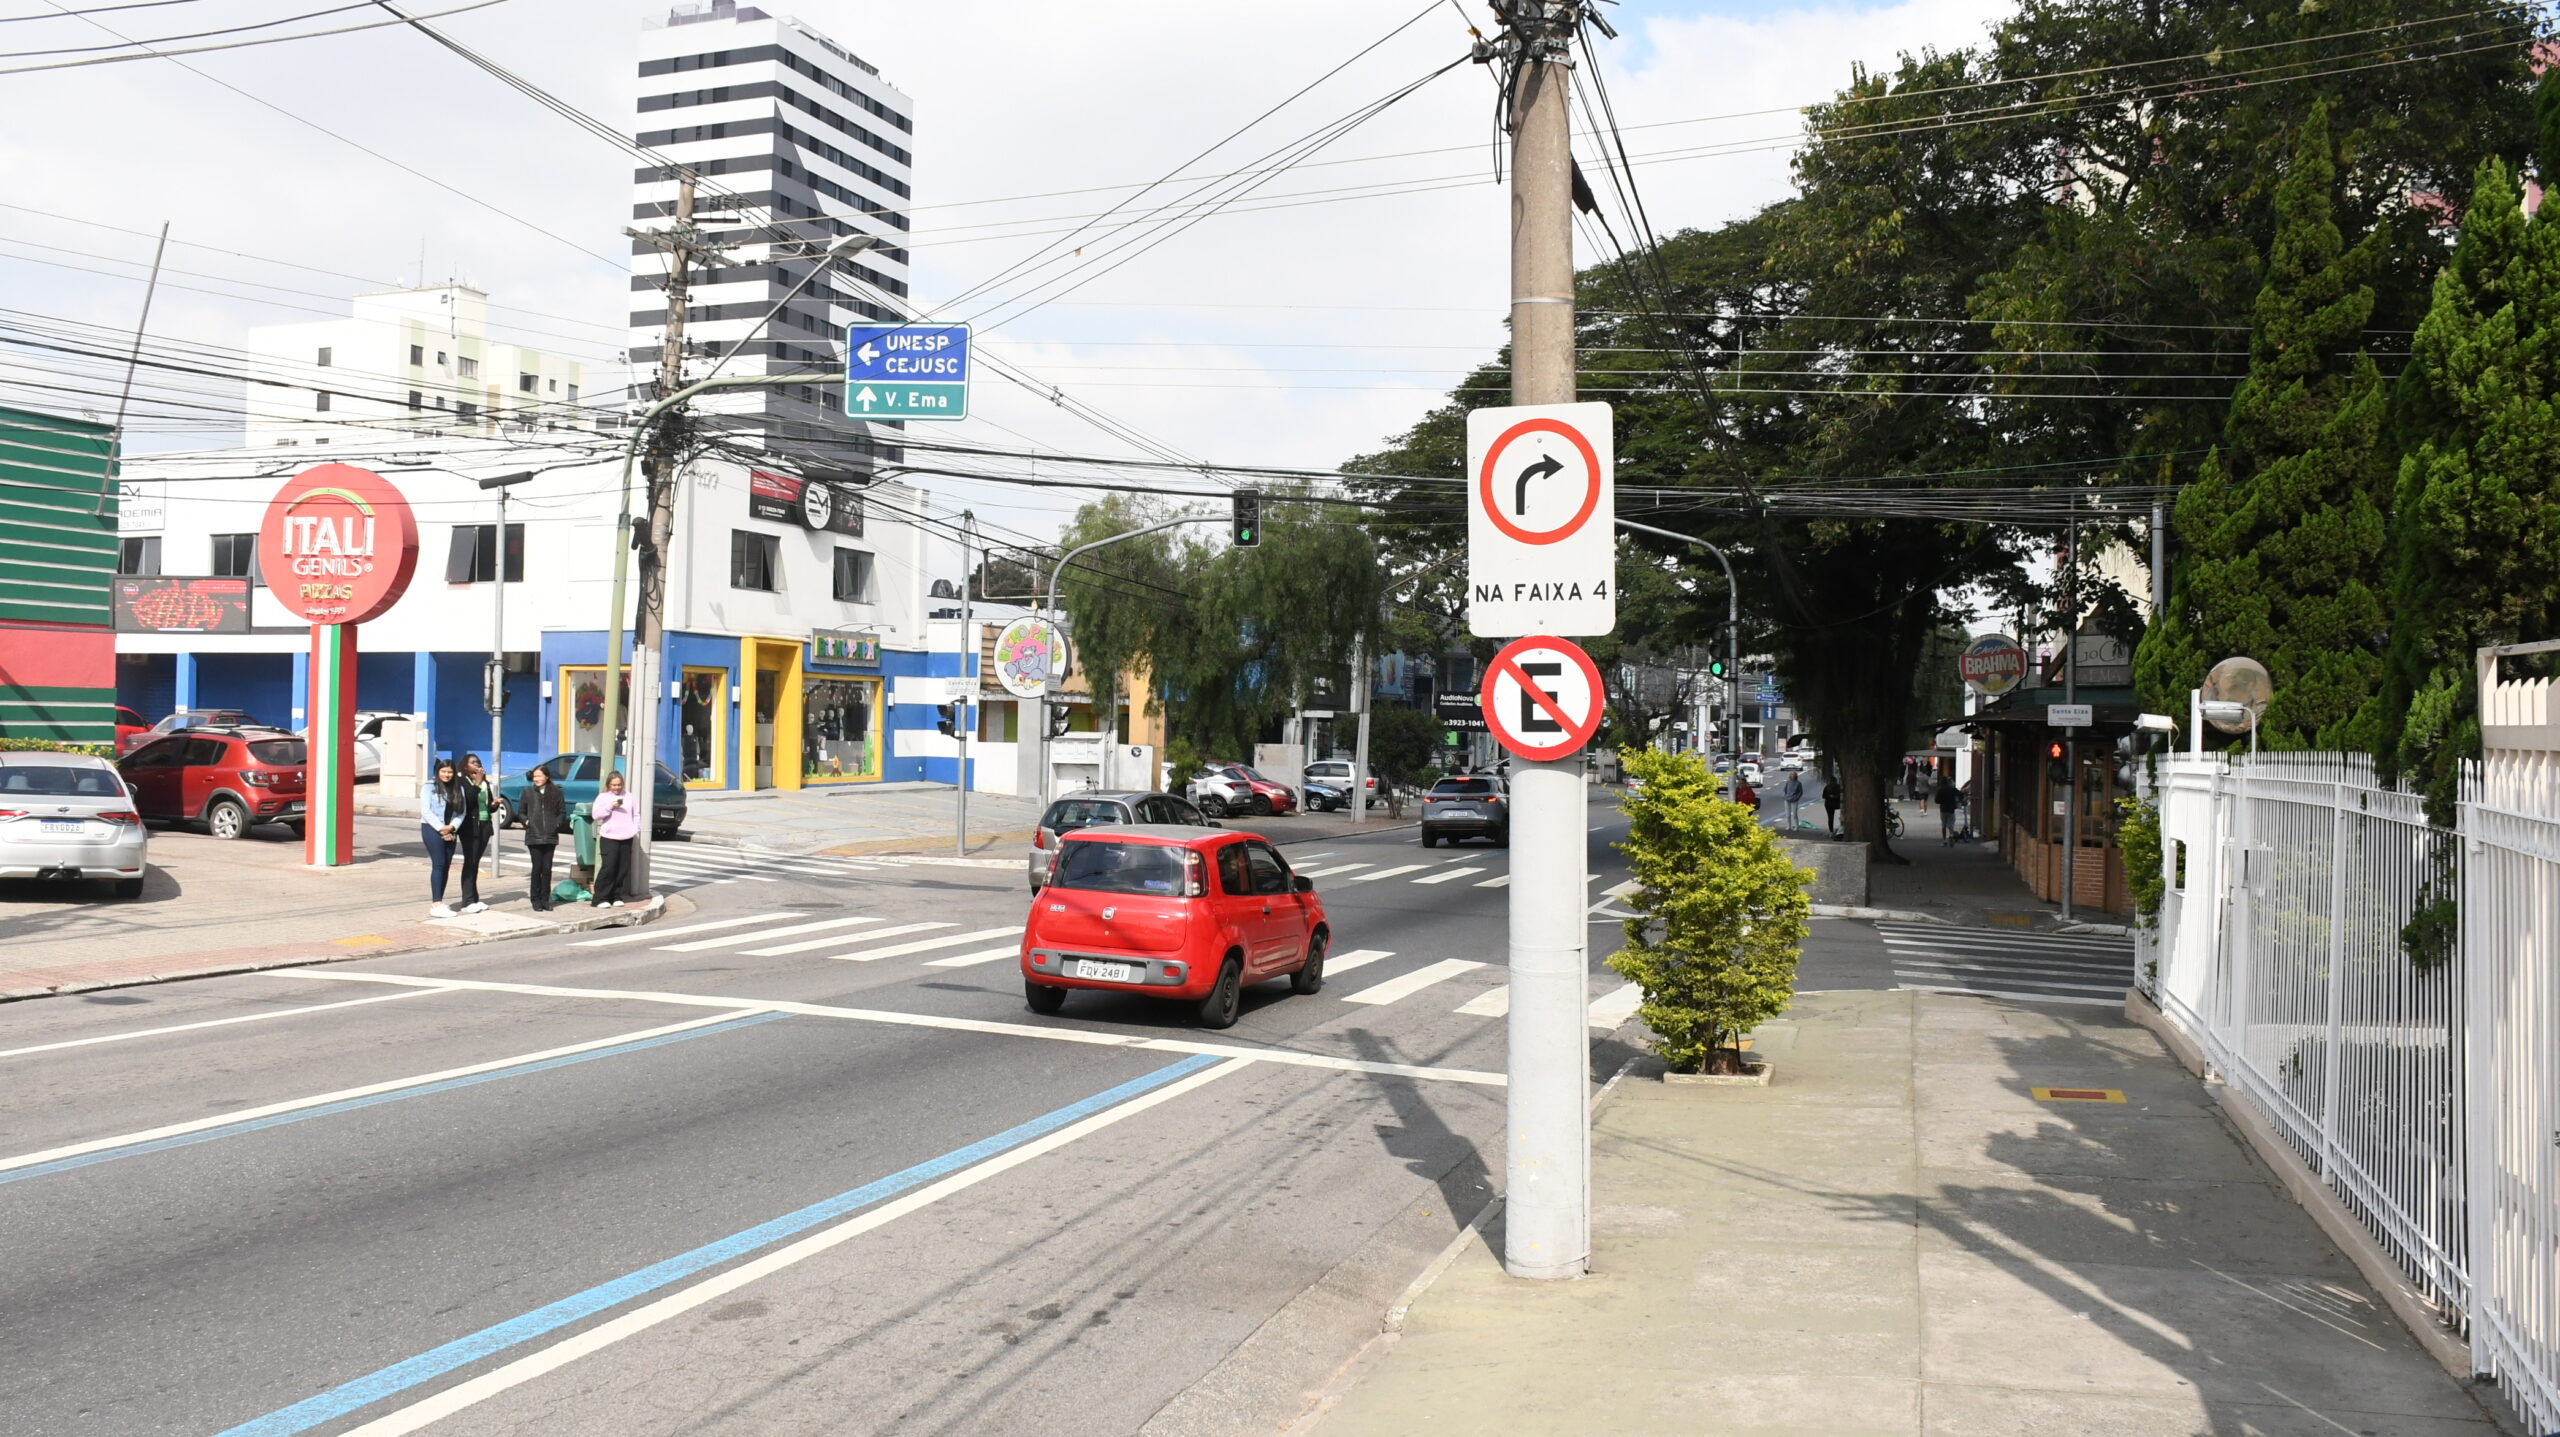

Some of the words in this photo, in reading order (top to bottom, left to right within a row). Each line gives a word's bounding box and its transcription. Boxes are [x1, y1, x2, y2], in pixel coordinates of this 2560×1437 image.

[886, 335, 949, 351] UNESP
[885, 357, 958, 374] CEJUSC
[885, 392, 901, 407] V.
[908, 392, 948, 407] Ema
[282, 516, 376, 557] ITALI
[300, 583, 353, 600] PIZZAS
[1476, 584, 1504, 603] NA
[1514, 583, 1583, 602] FAIXA
[1593, 580, 1608, 600] 4
[1965, 653, 2020, 675] BRAHMA
[1440, 694, 1474, 702] AudioNova
[1449, 719, 1485, 727] 3923-1041
